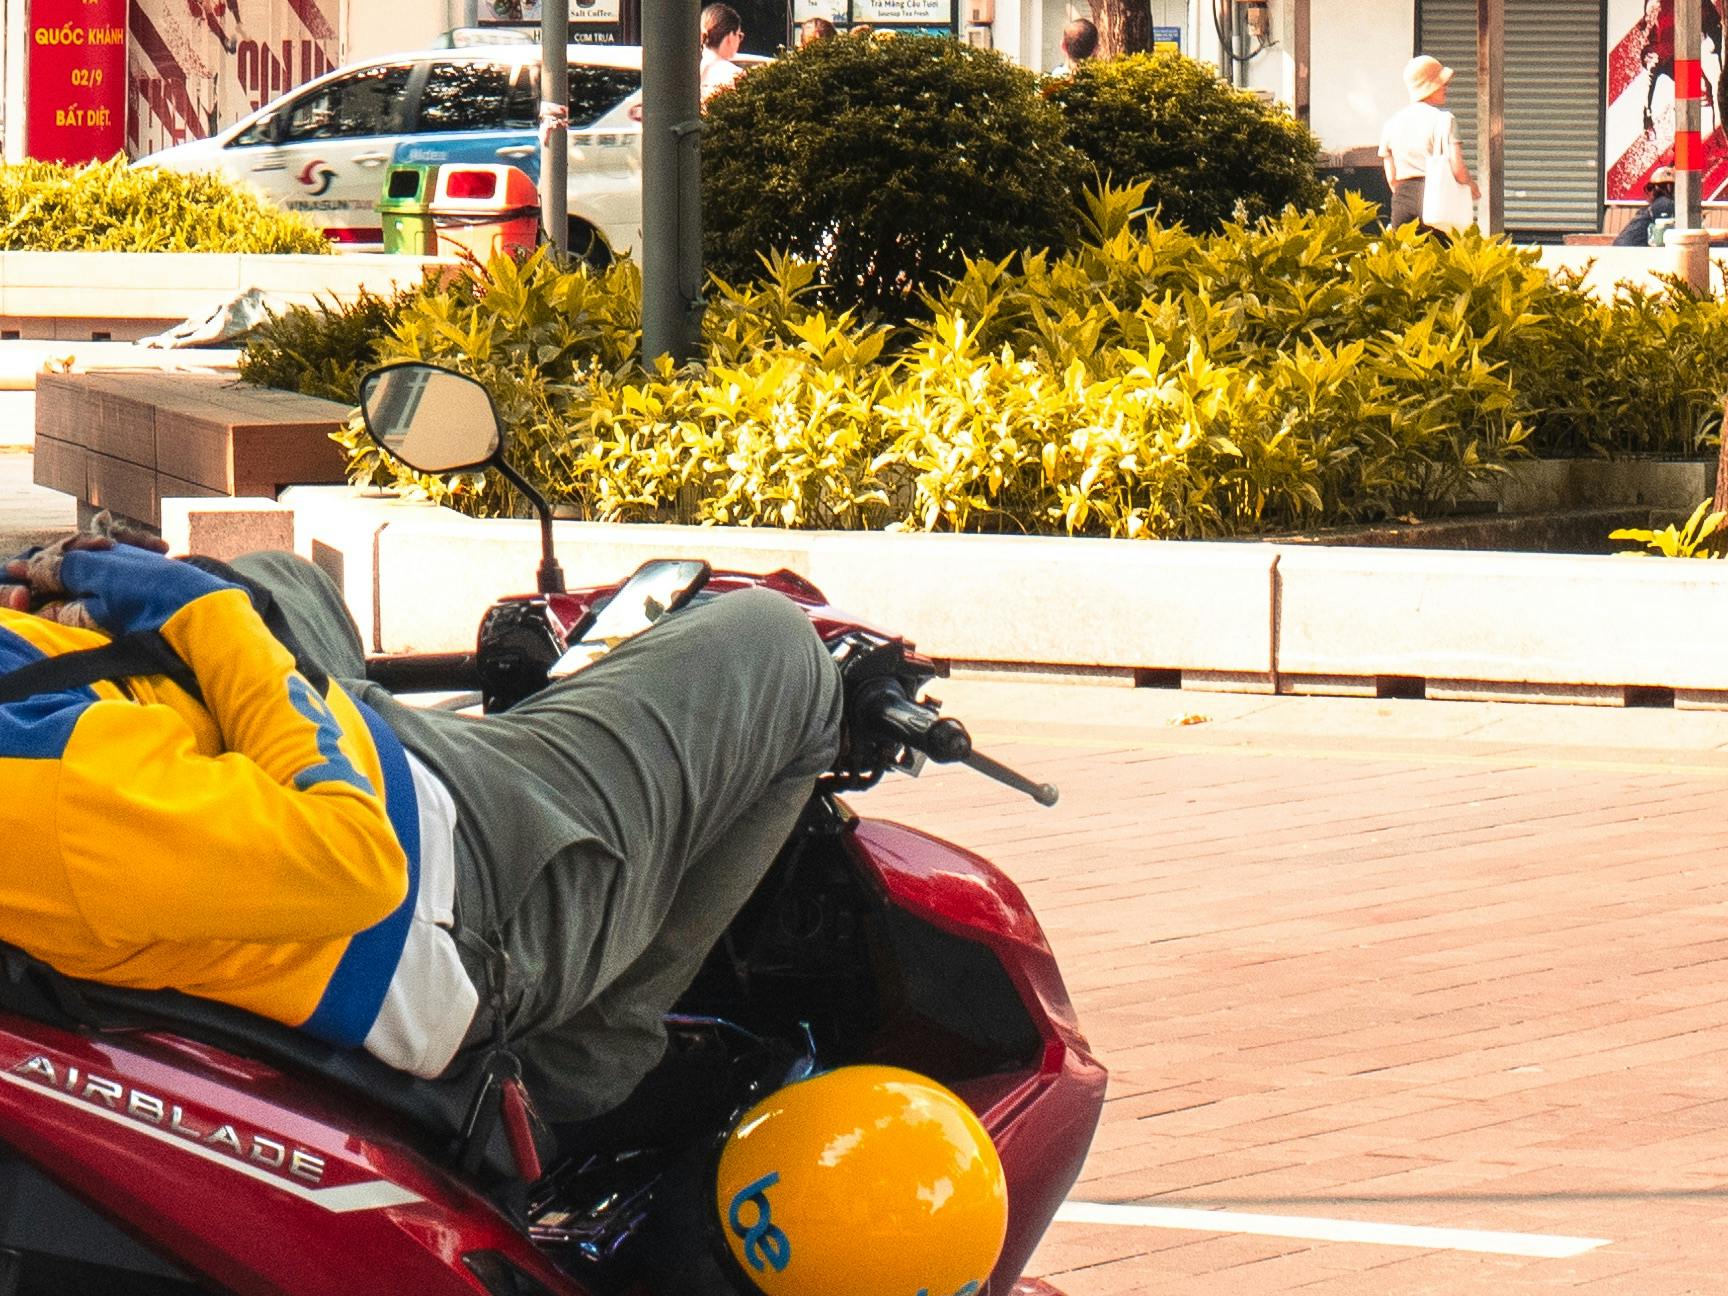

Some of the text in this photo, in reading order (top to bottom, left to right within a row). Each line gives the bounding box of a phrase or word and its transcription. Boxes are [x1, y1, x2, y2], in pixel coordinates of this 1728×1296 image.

[871, 0, 883, 9] Trà
[35, 21, 124, 46] QUỐC KHÁNH
[71, 69, 103, 87] 02/9
[56, 103, 83, 127] BẤT
[16, 1054, 326, 1184] AIRBLADE
[728, 1170, 792, 1273] be
